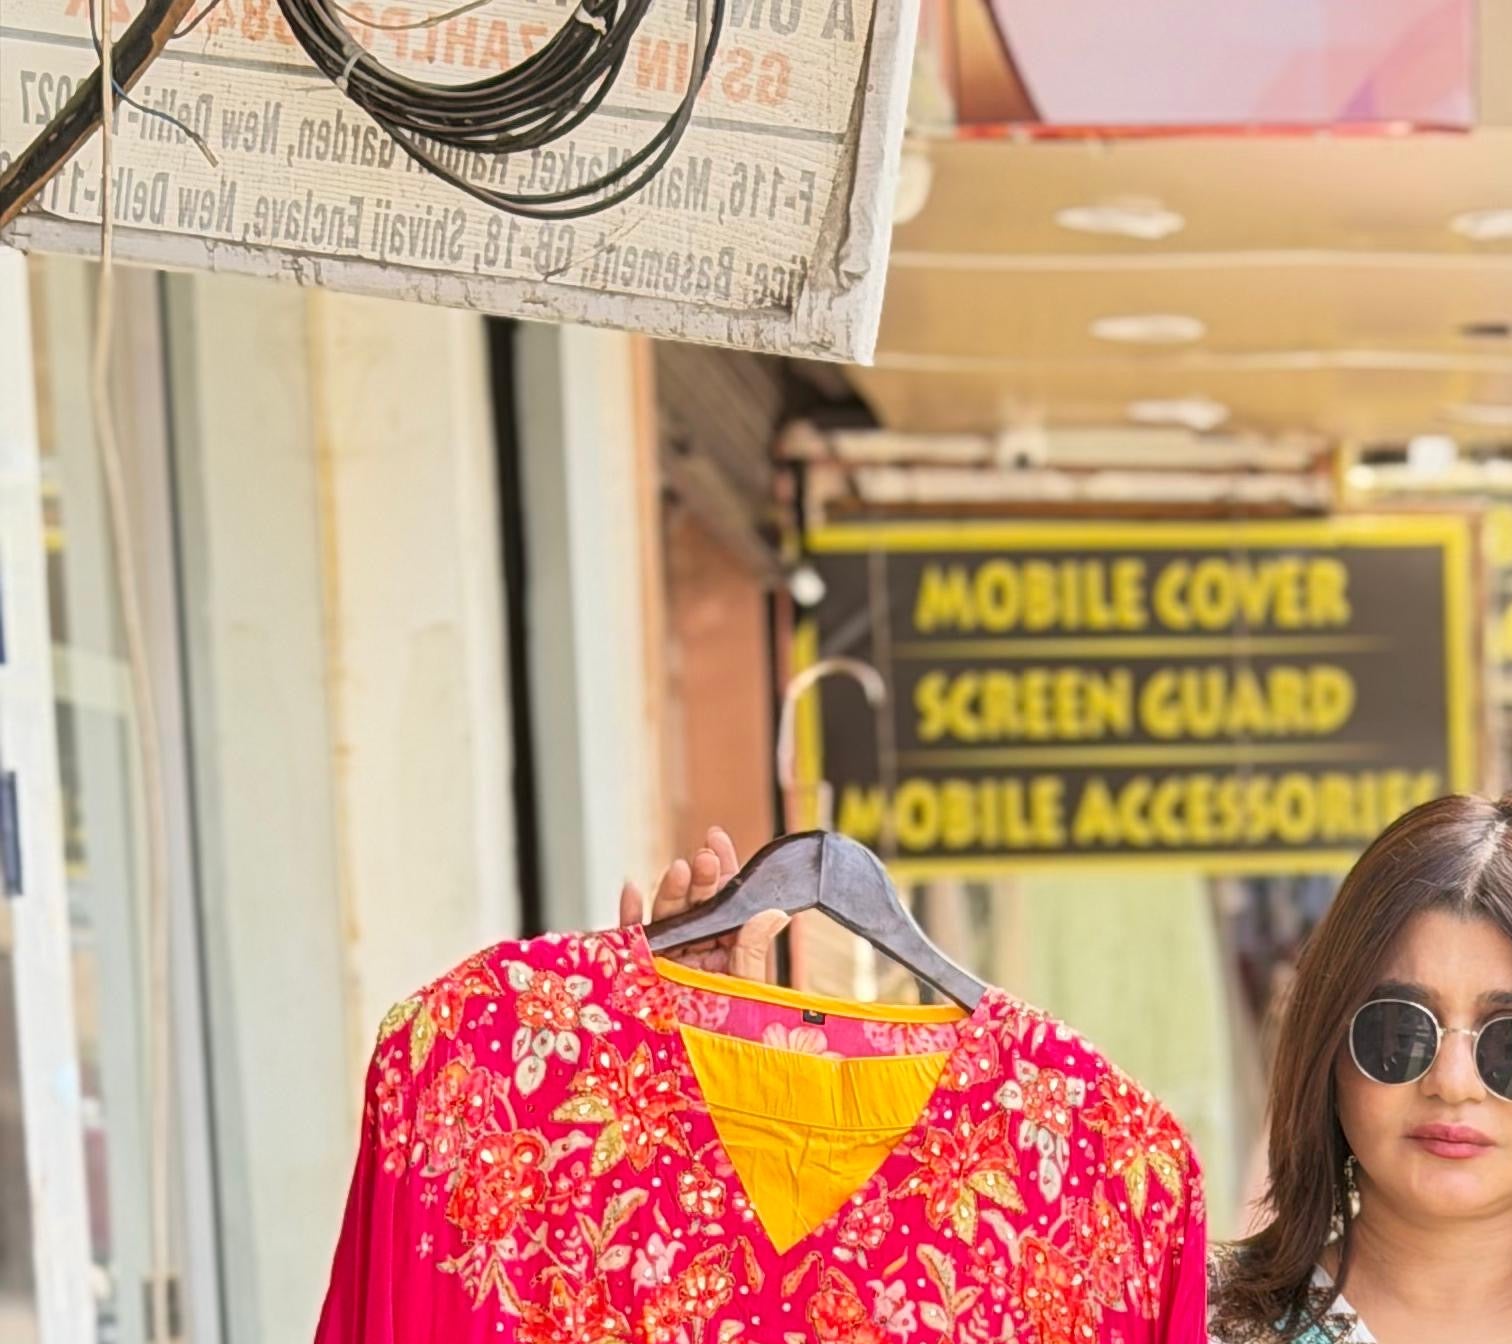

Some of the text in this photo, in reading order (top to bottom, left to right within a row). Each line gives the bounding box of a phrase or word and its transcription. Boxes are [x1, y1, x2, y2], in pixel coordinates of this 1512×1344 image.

[912, 554, 1353, 634] MOBILE COVER
[912, 663, 1357, 741] SCREEN GUARD
[838, 776, 1067, 850] MOBILE
